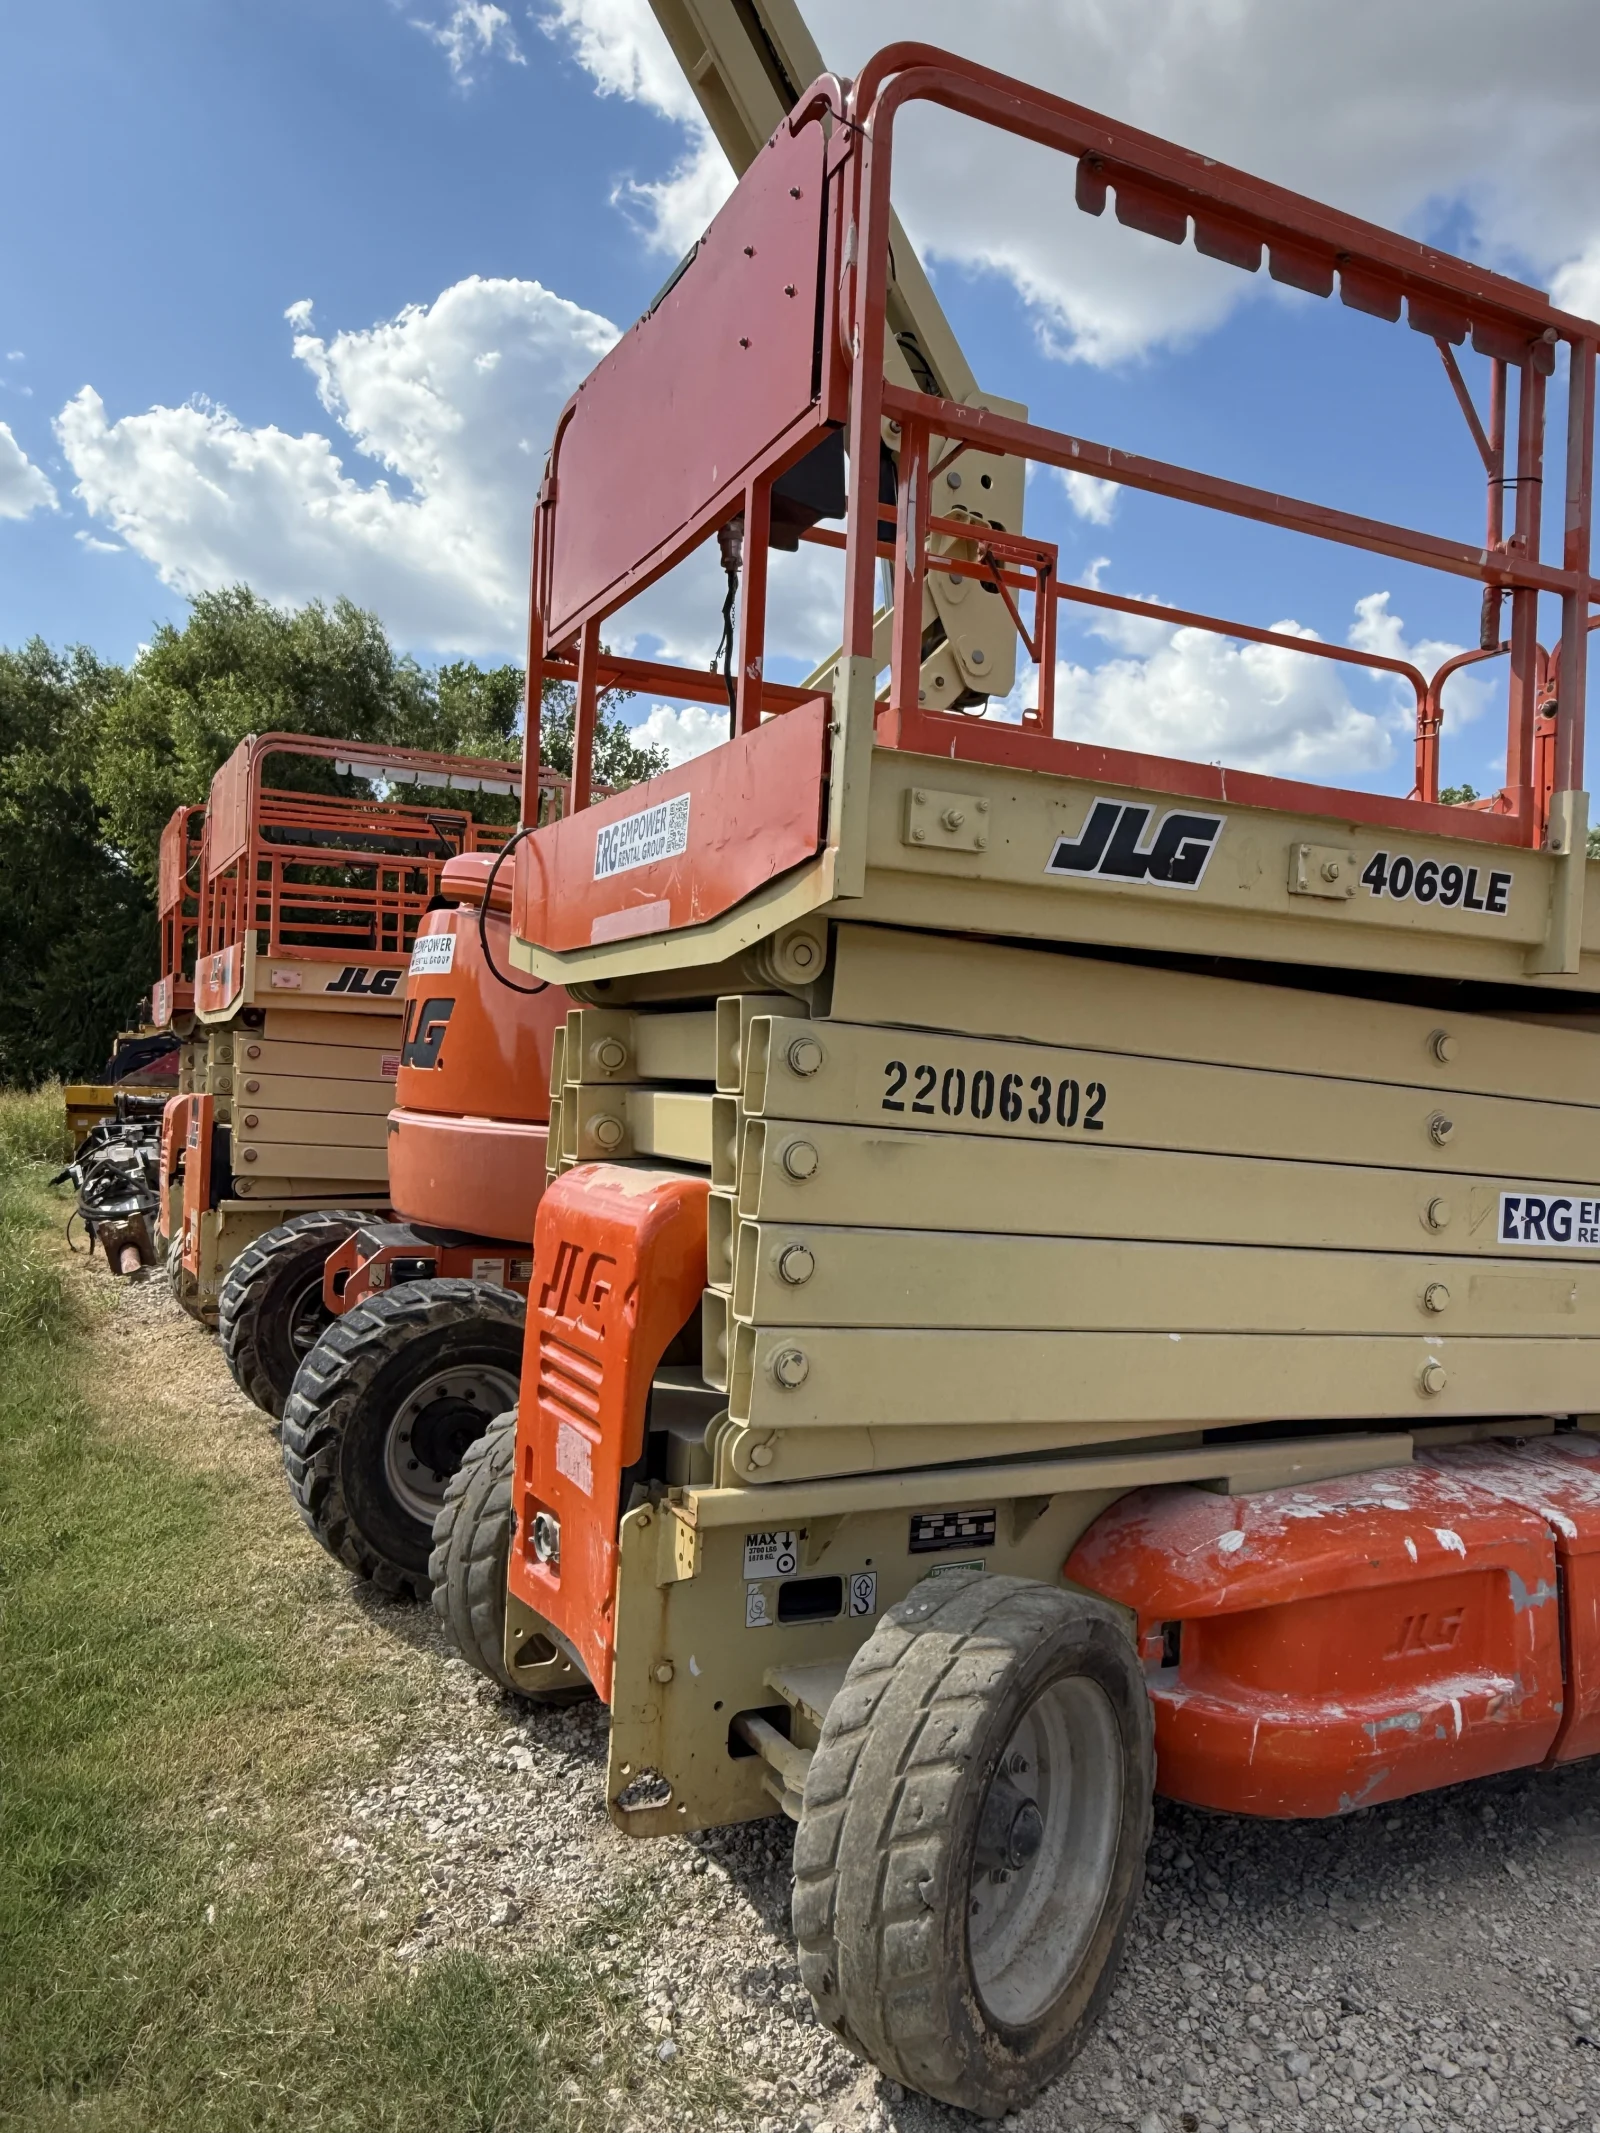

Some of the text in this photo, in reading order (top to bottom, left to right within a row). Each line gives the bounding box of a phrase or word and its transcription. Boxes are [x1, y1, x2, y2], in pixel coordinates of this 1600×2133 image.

[595, 825, 620, 876] ERG
[618, 836, 666, 868] RENTAL GROUP
[620, 806, 667, 848] EMPOWER
[1046, 797, 1226, 889] JLG
[1360, 851, 1512, 914] 4069LE
[323, 966, 403, 996] JLG
[882, 1061, 1107, 1130] 22006302
[1502, 1197, 1573, 1243] ERG
[538, 1240, 617, 1341] JLG
[747, 1532, 777, 1547] MAX
[1383, 1607, 1466, 1661] JLG
